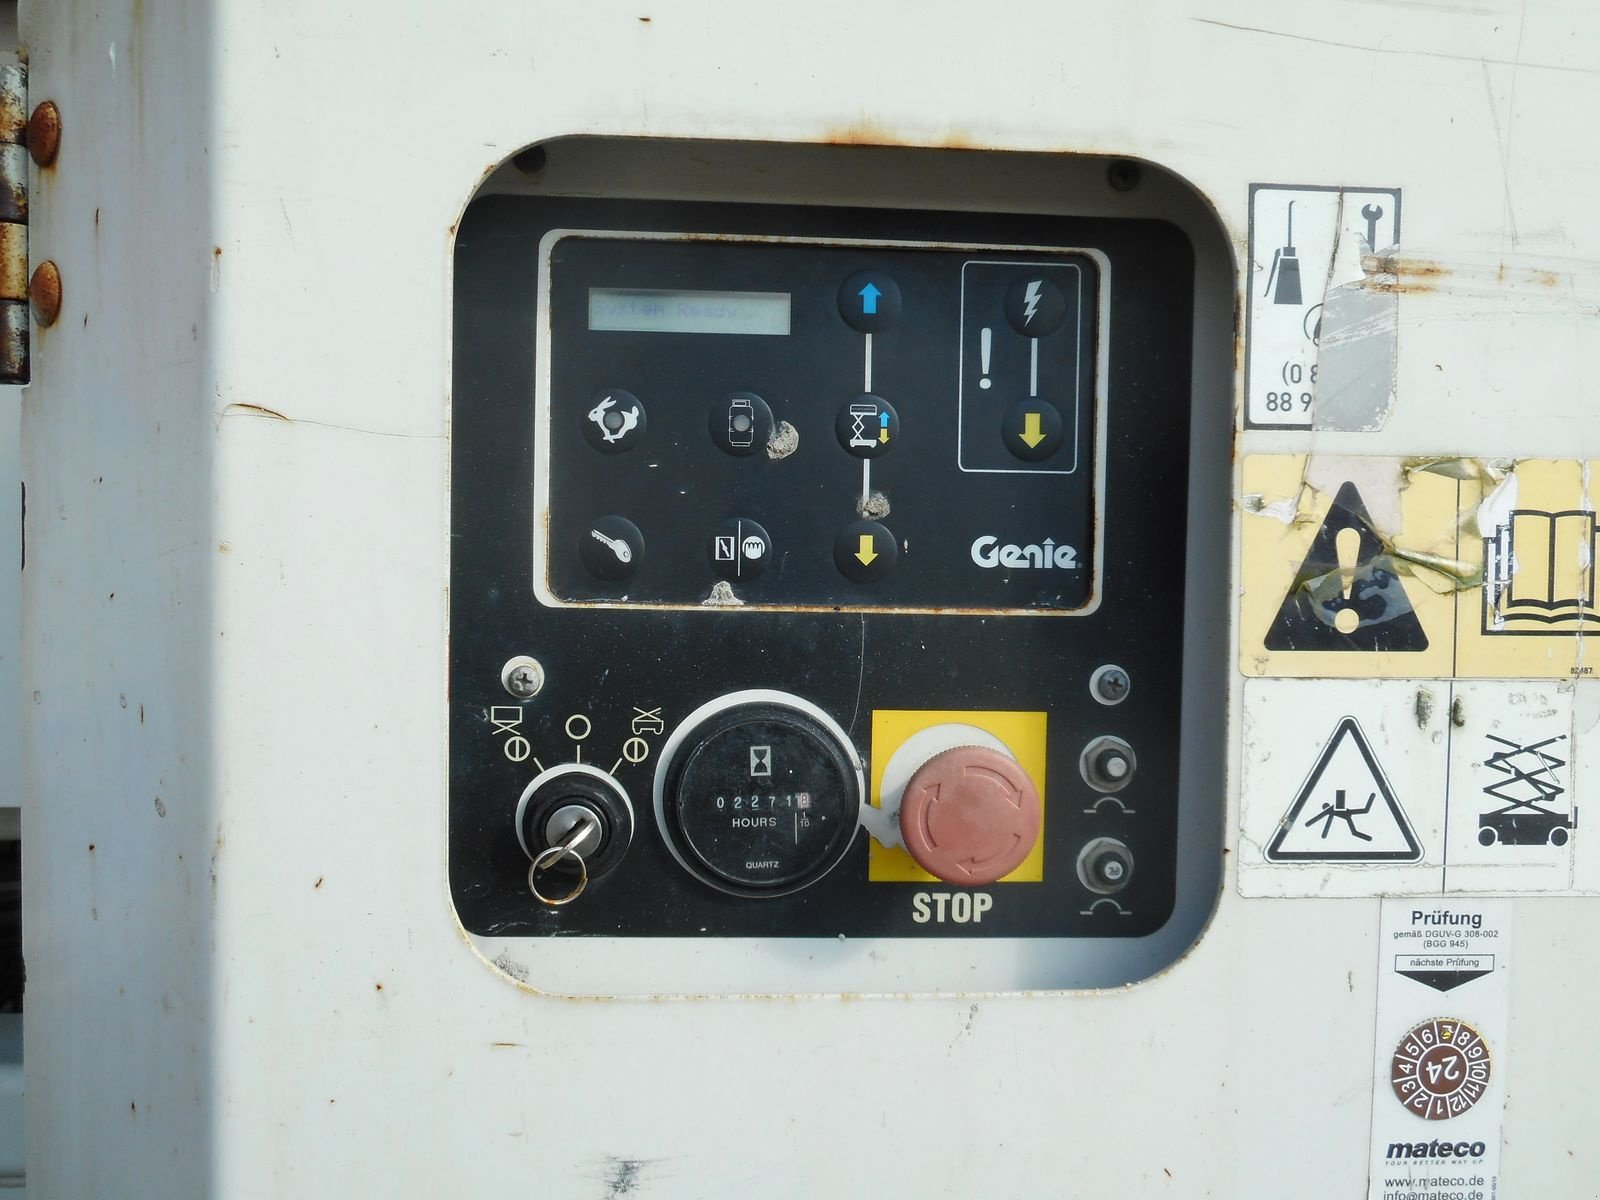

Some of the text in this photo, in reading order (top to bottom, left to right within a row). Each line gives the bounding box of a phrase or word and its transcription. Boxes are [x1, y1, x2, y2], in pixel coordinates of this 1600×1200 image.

[677, 302, 738, 319] Ready
[1266, 391, 1292, 412] 88
[970, 535, 1077, 569] Genie
[732, 817, 777, 828] HOURS
[745, 861, 780, 869] QUARTZ
[912, 891, 993, 924] STOP
[1411, 910, 1482, 929] Prüfung
[1393, 929, 1499, 940] gemäß DGUV-G 308-002
[1423, 939, 1469, 949] (BGG 945)
[1409, 957, 1480, 968] nächste Prüfung
[1421, 1029, 1433, 1044] 6
[1457, 1031, 1470, 1046] 8
[1404, 1042, 1420, 1056] 5
[1468, 1046, 1483, 1058] 9
[1398, 1063, 1413, 1074] 4
[1425, 1055, 1460, 1085] 24
[1471, 1062, 1487, 1079] 10
[1401, 1080, 1416, 1093] 3
[1463, 1083, 1480, 1098] 11
[1413, 1092, 1429, 1108] 2
[1436, 1099, 1444, 1115] 1
[1450, 1094, 1467, 1112] 12
[1385, 1138, 1486, 1159] mateco
[1384, 1175, 1485, 1188] www.mateco.de
[1383, 1189, 1484, 1200] info@mateco.de
